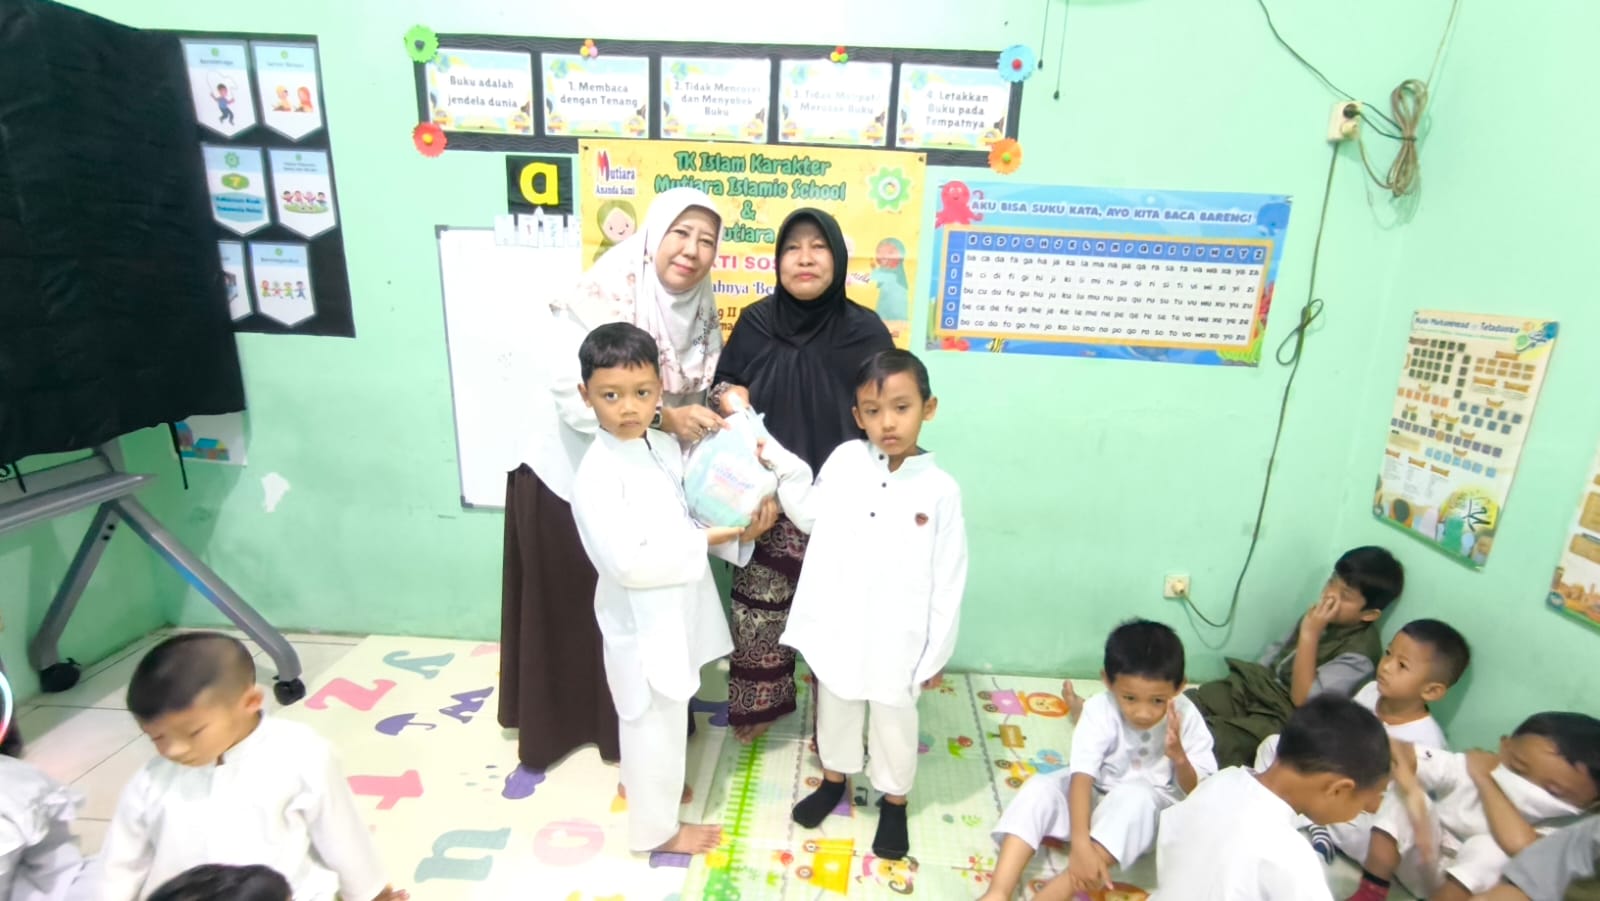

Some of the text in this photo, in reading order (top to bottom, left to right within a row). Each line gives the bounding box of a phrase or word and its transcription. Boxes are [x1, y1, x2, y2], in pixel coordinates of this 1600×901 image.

[449, 75, 514, 89] Buku adalah
[578, 81, 629, 94] Membaca
[684, 81, 712, 92] Tidak
[448, 94, 518, 109] jendela dunia
[560, 94, 639, 108] dengan Tenang
[681, 94, 700, 103] dan
[939, 91, 989, 102] Letakkan
[928, 103, 985, 116] Buku pada
[926, 116, 985, 130] Tempatnya
[674, 151, 832, 176] TK Islam Karakter
[727, 177, 788, 198] Islamic
[791, 179, 847, 201] School
[740, 200, 756, 221] &
[971, 201, 1252, 224] AKU BISA SUKU KATA, AYO KITA BACA BARENG!
[722, 223, 775, 244] utiara
[712, 255, 738, 269] TI
